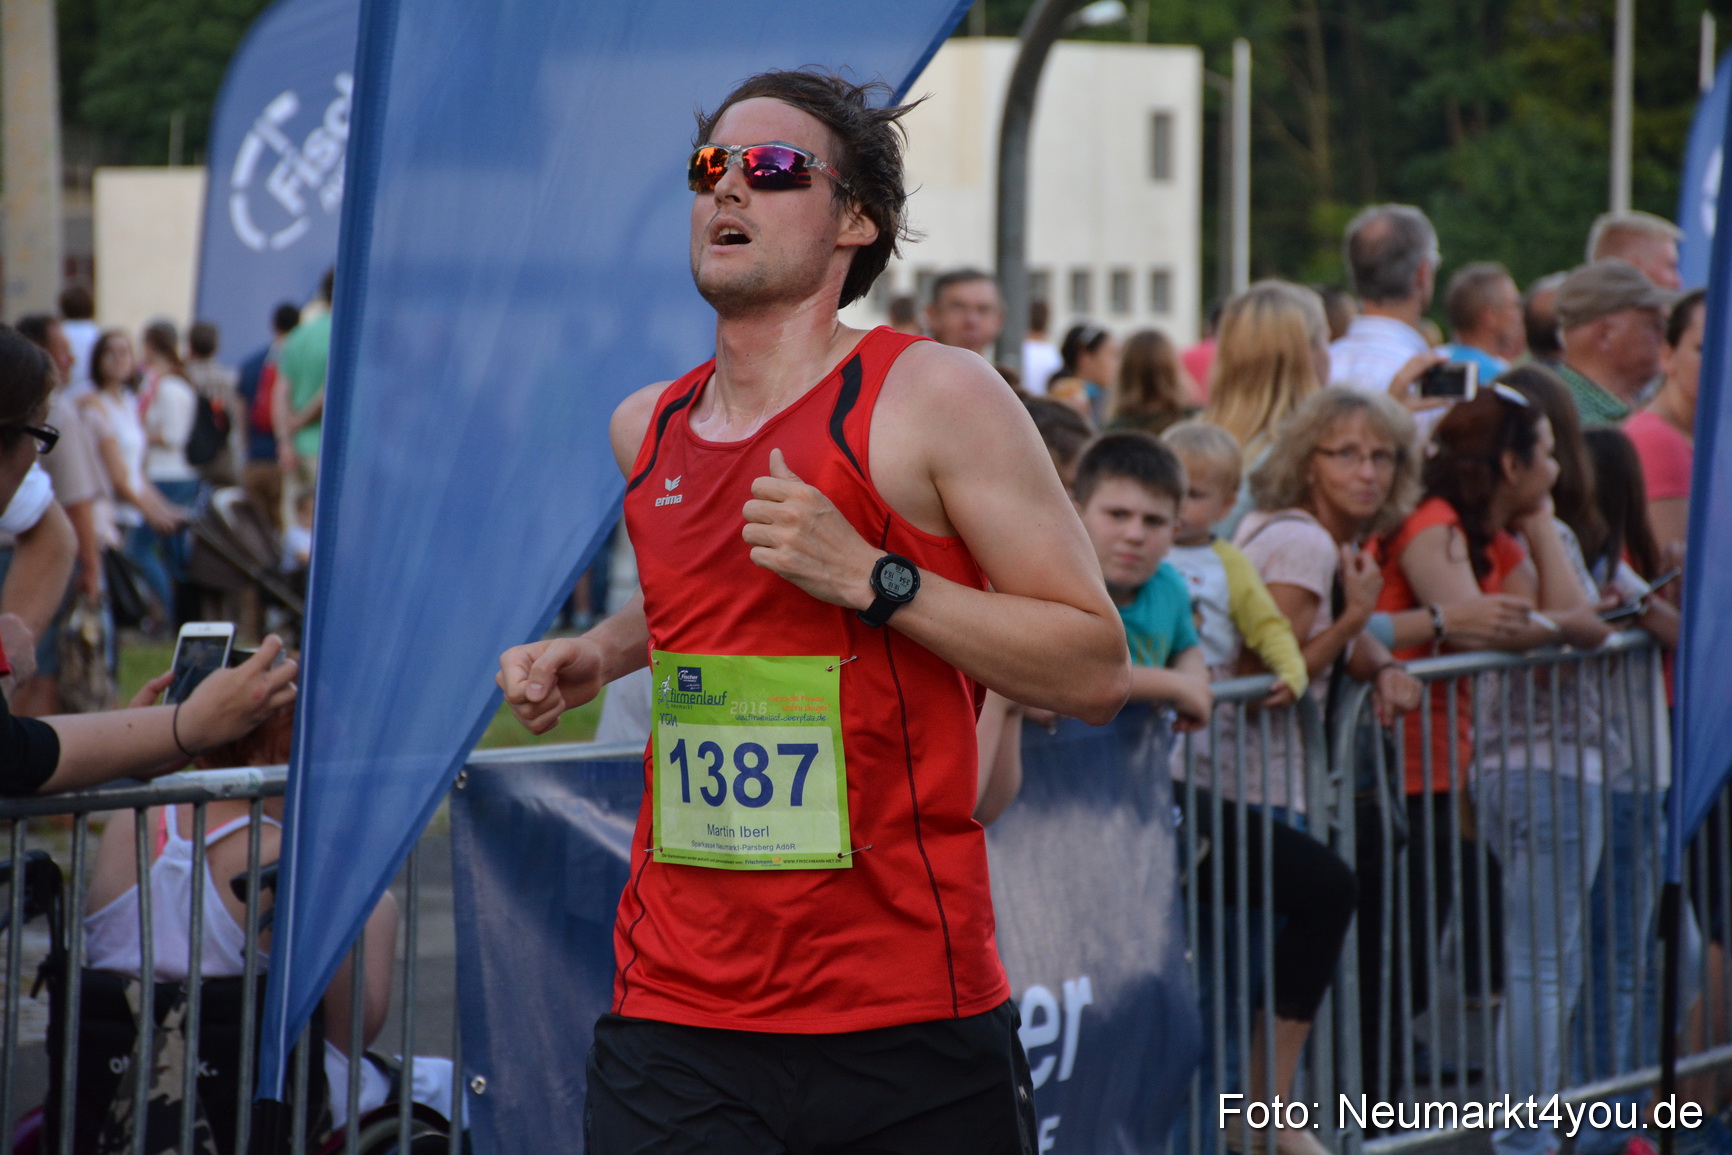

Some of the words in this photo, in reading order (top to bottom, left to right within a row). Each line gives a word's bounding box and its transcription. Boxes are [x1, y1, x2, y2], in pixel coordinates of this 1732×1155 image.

[655, 494, 683, 507] erima
[680, 672, 698, 680] Fischer
[670, 689, 727, 706] firmenlauf
[730, 701, 768, 715] 2016
[669, 738, 820, 809] 1387
[707, 823, 735, 838] Martin
[740, 825, 770, 838] Iberl
[691, 839, 715, 848] Sparkasse
